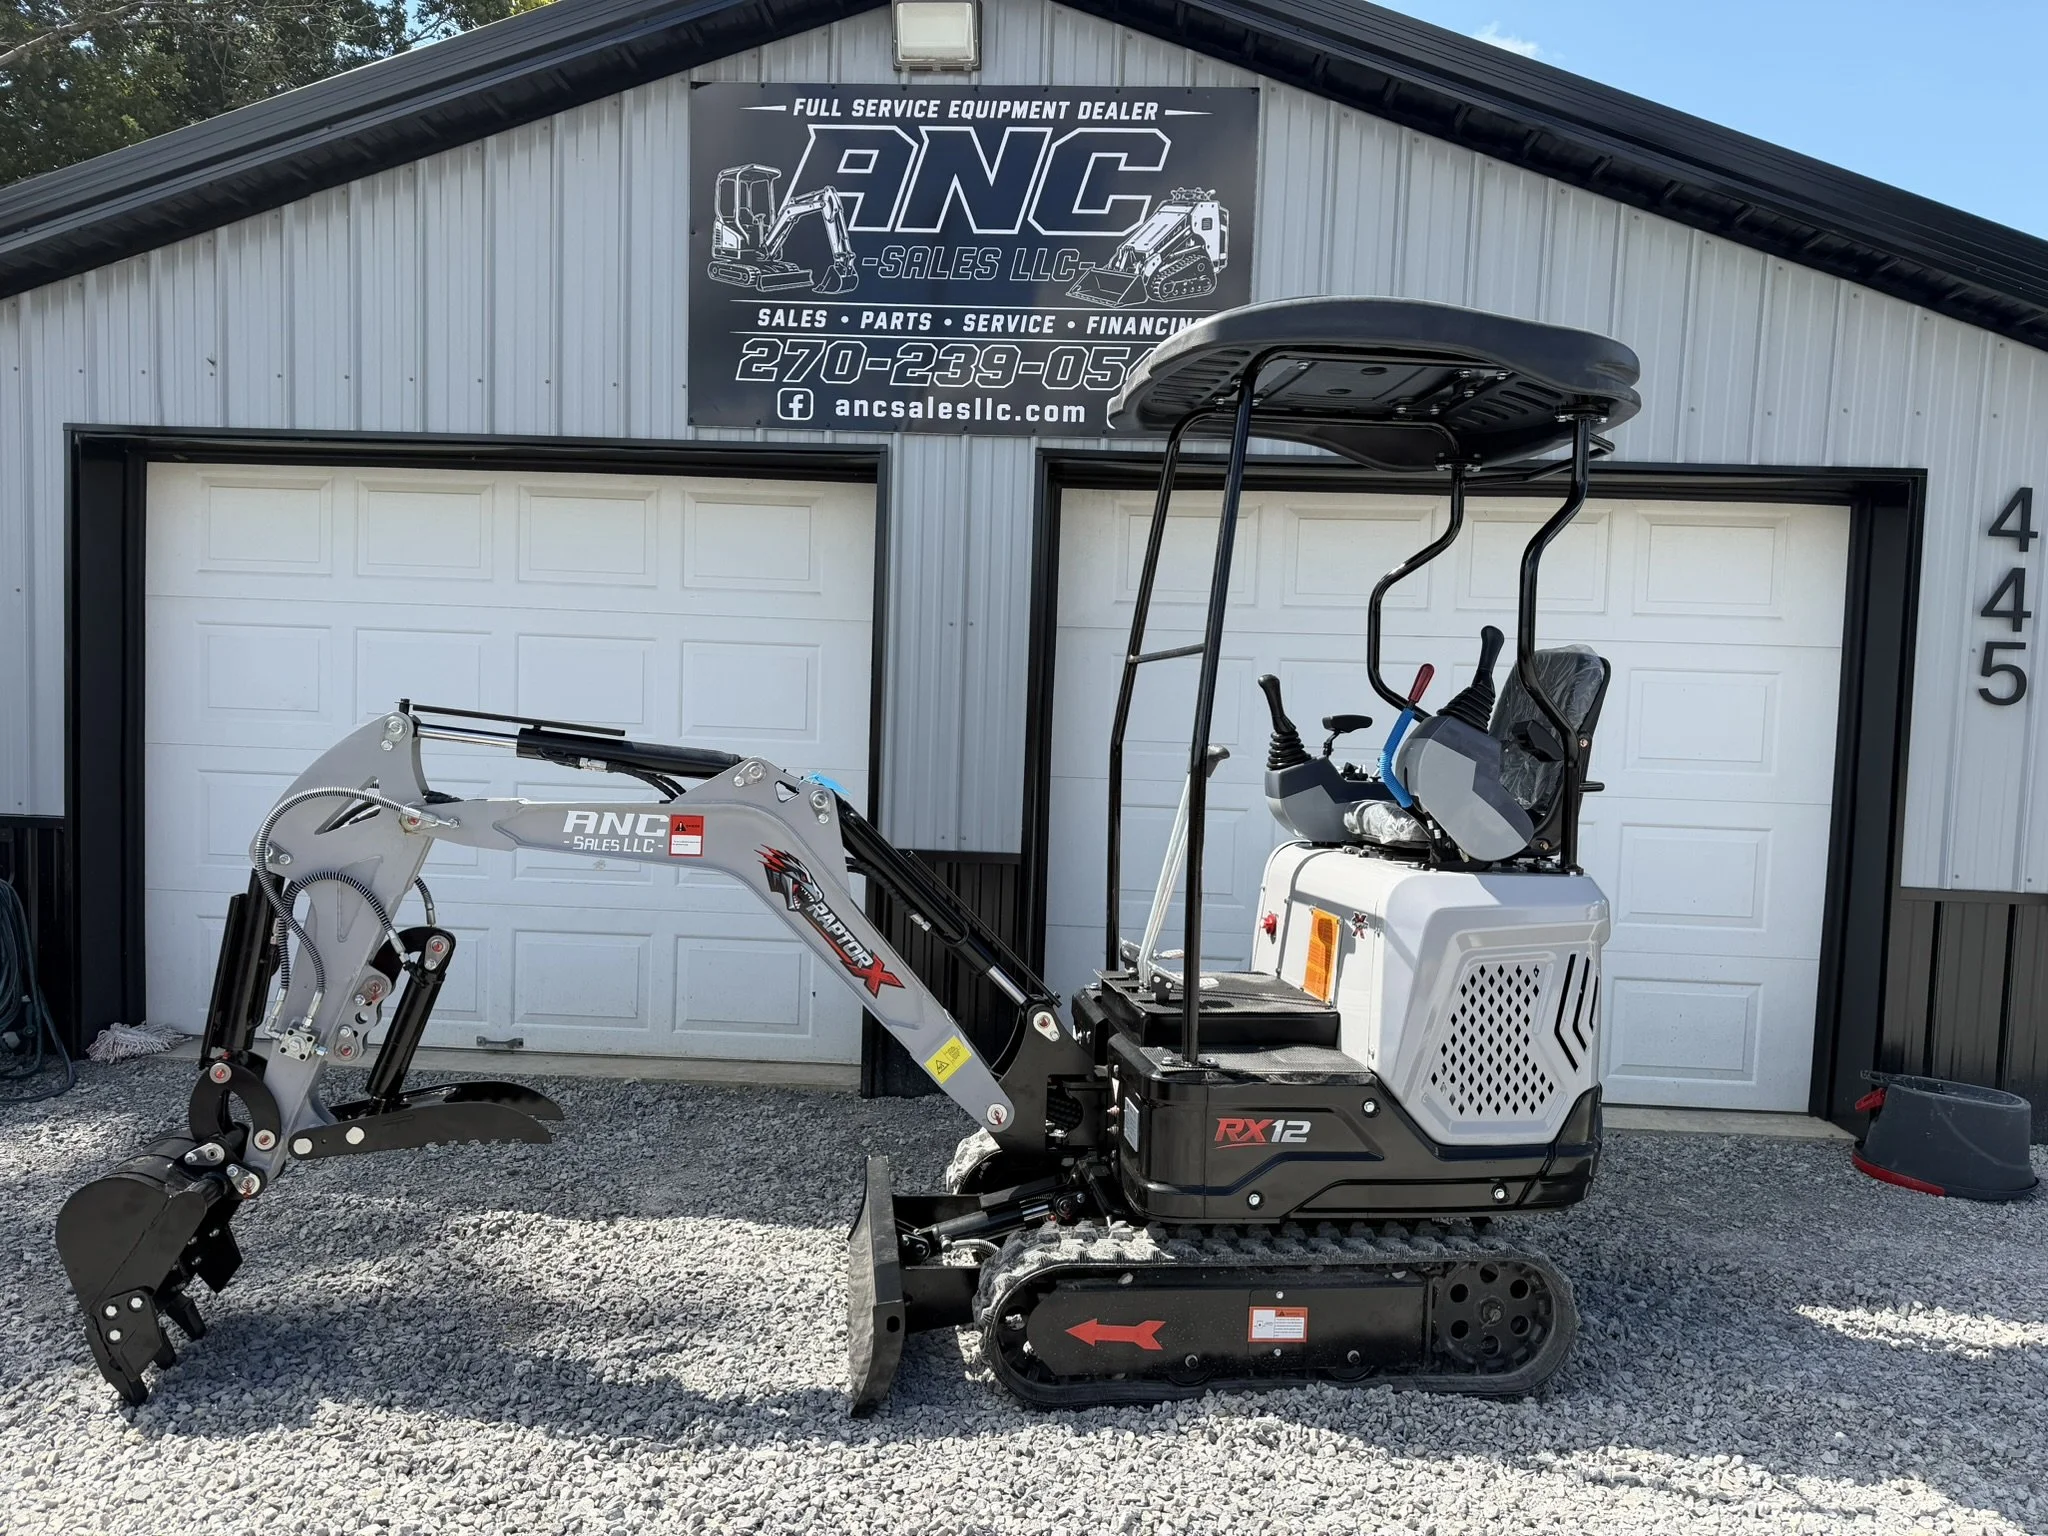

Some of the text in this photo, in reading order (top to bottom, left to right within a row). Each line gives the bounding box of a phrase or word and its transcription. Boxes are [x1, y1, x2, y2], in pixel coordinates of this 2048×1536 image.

[793, 98, 1159, 121] FULL SERVICE EQUIPMENT DEALER
[778, 124, 1172, 236] ANC
[757, 308, 1204, 335] SALES PARTS SERVICE FINANCIN
[735, 337, 1156, 391] 270-239-05
[835, 396, 1086, 424] ancsalesllc.com
[562, 810, 670, 837] ANC
[623, 838, 655, 853] LLC
[1213, 1117, 1312, 1143] RX12
